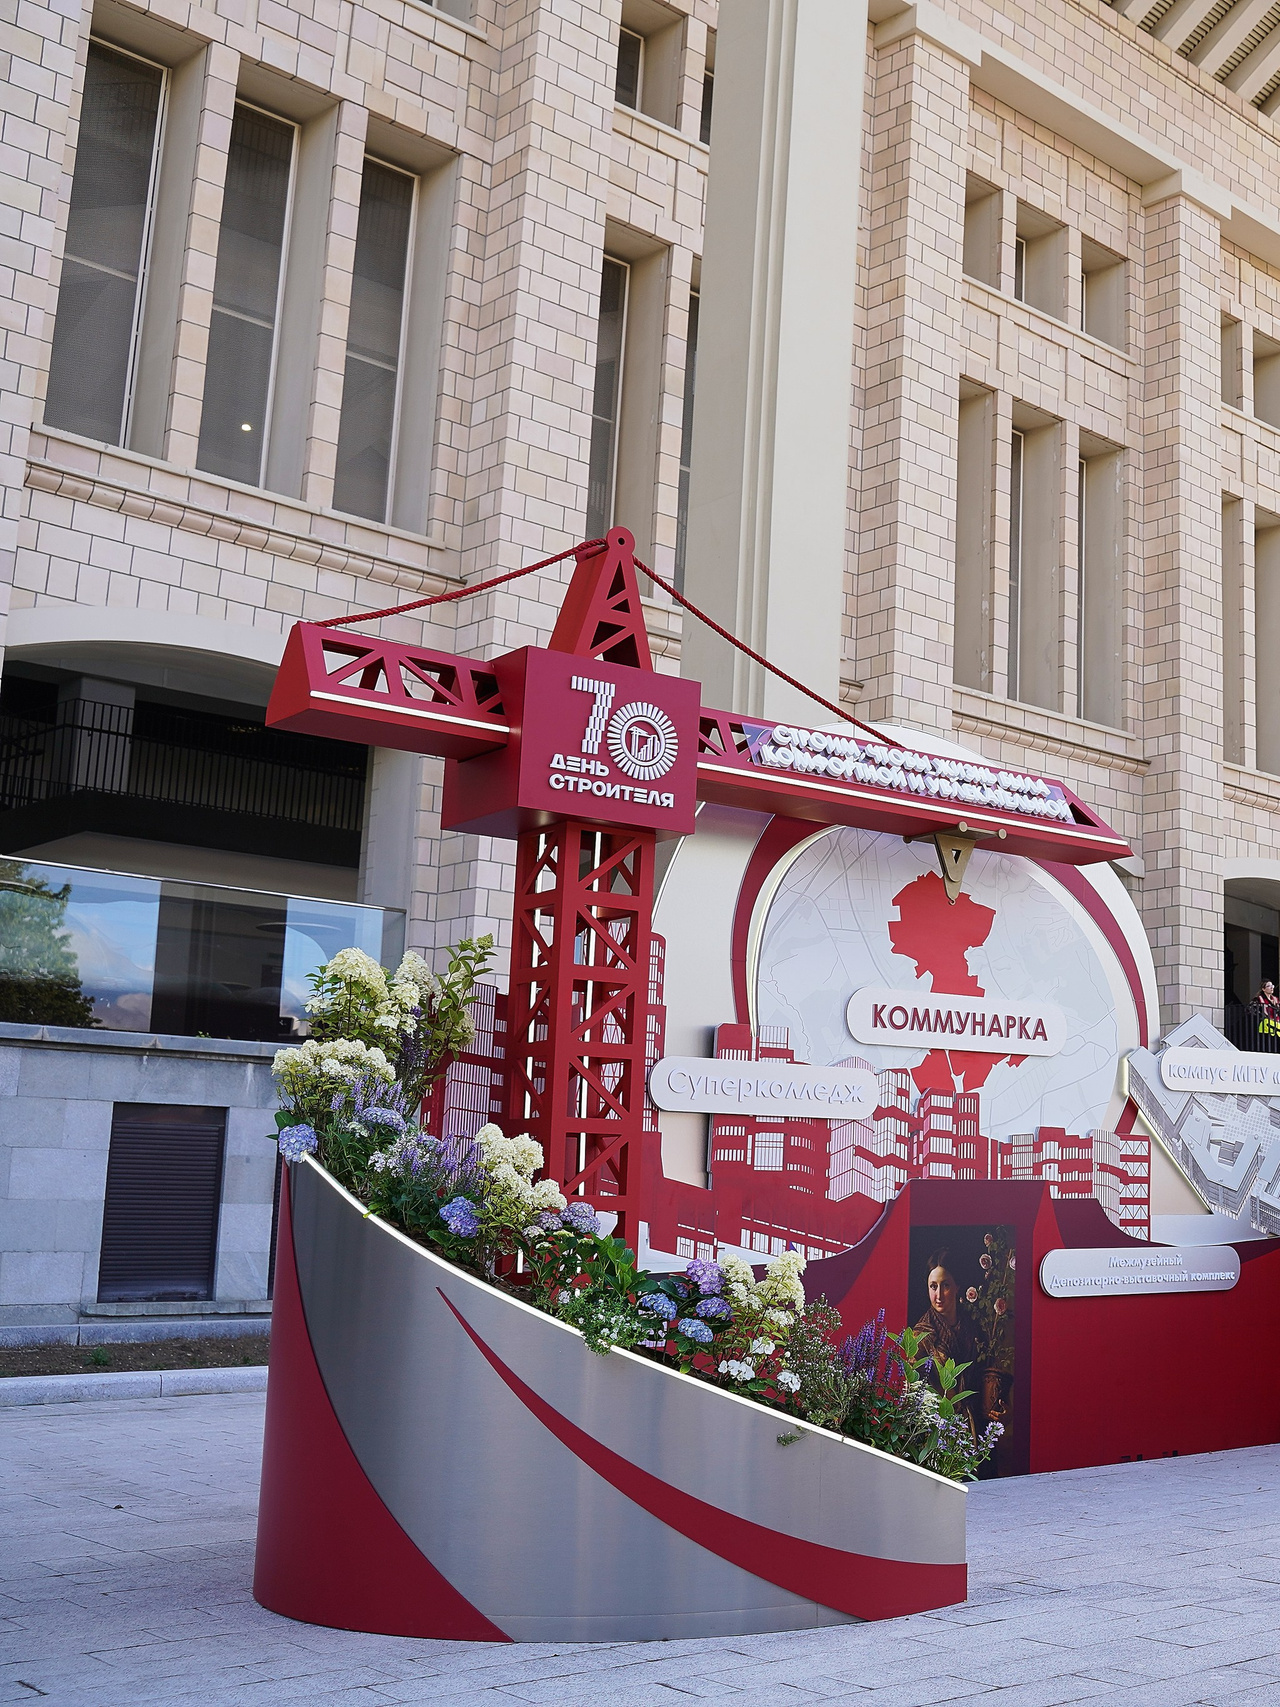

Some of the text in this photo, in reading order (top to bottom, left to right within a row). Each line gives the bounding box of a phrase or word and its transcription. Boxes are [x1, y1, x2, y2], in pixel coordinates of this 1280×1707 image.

[549, 753, 610, 777] ДЕНЬ
[549, 773, 675, 808] СТРОИТЕЛЯ
[871, 1003, 1049, 1042] КОММУНАРКА
[667, 1066, 866, 1104] Суперколледж
[1108, 1254, 1183, 1271] Межмузейный
[1050, 1270, 1236, 1289] Депозитарно-выставочный комплекс
